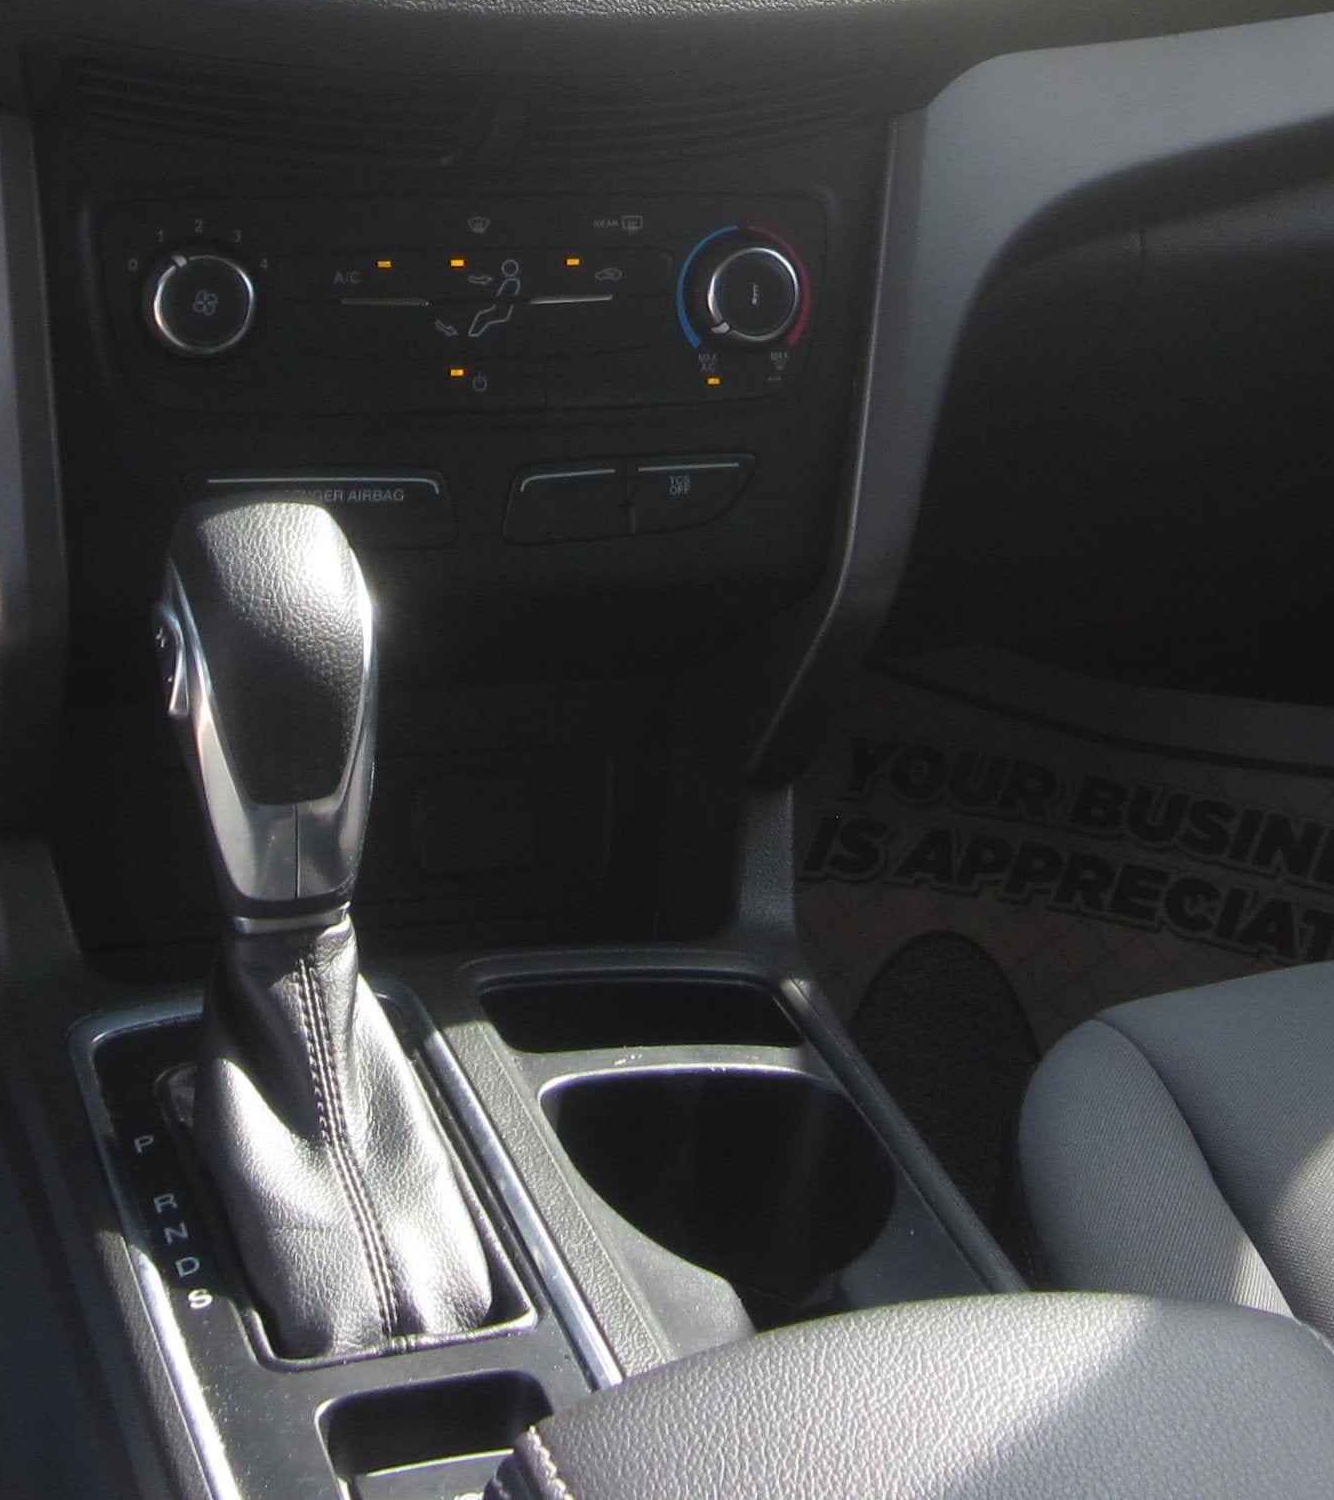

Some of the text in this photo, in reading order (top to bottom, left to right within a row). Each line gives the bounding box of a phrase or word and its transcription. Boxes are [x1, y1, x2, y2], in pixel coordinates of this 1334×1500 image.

[194, 219, 204, 233] 2
[232, 229, 243, 243] 3
[333, 270, 361, 285] A/C
[348, 488, 405, 501] AIRBAG
[669, 486, 691, 496] OFF
[843, 734, 1067, 824] YOUR
[797, 816, 893, 885] IS
[133, 1135, 154, 1155] P
[153, 1193, 178, 1215] R
[164, 1222, 189, 1244] N
[175, 1256, 201, 1278] D
[187, 1288, 214, 1310] S
